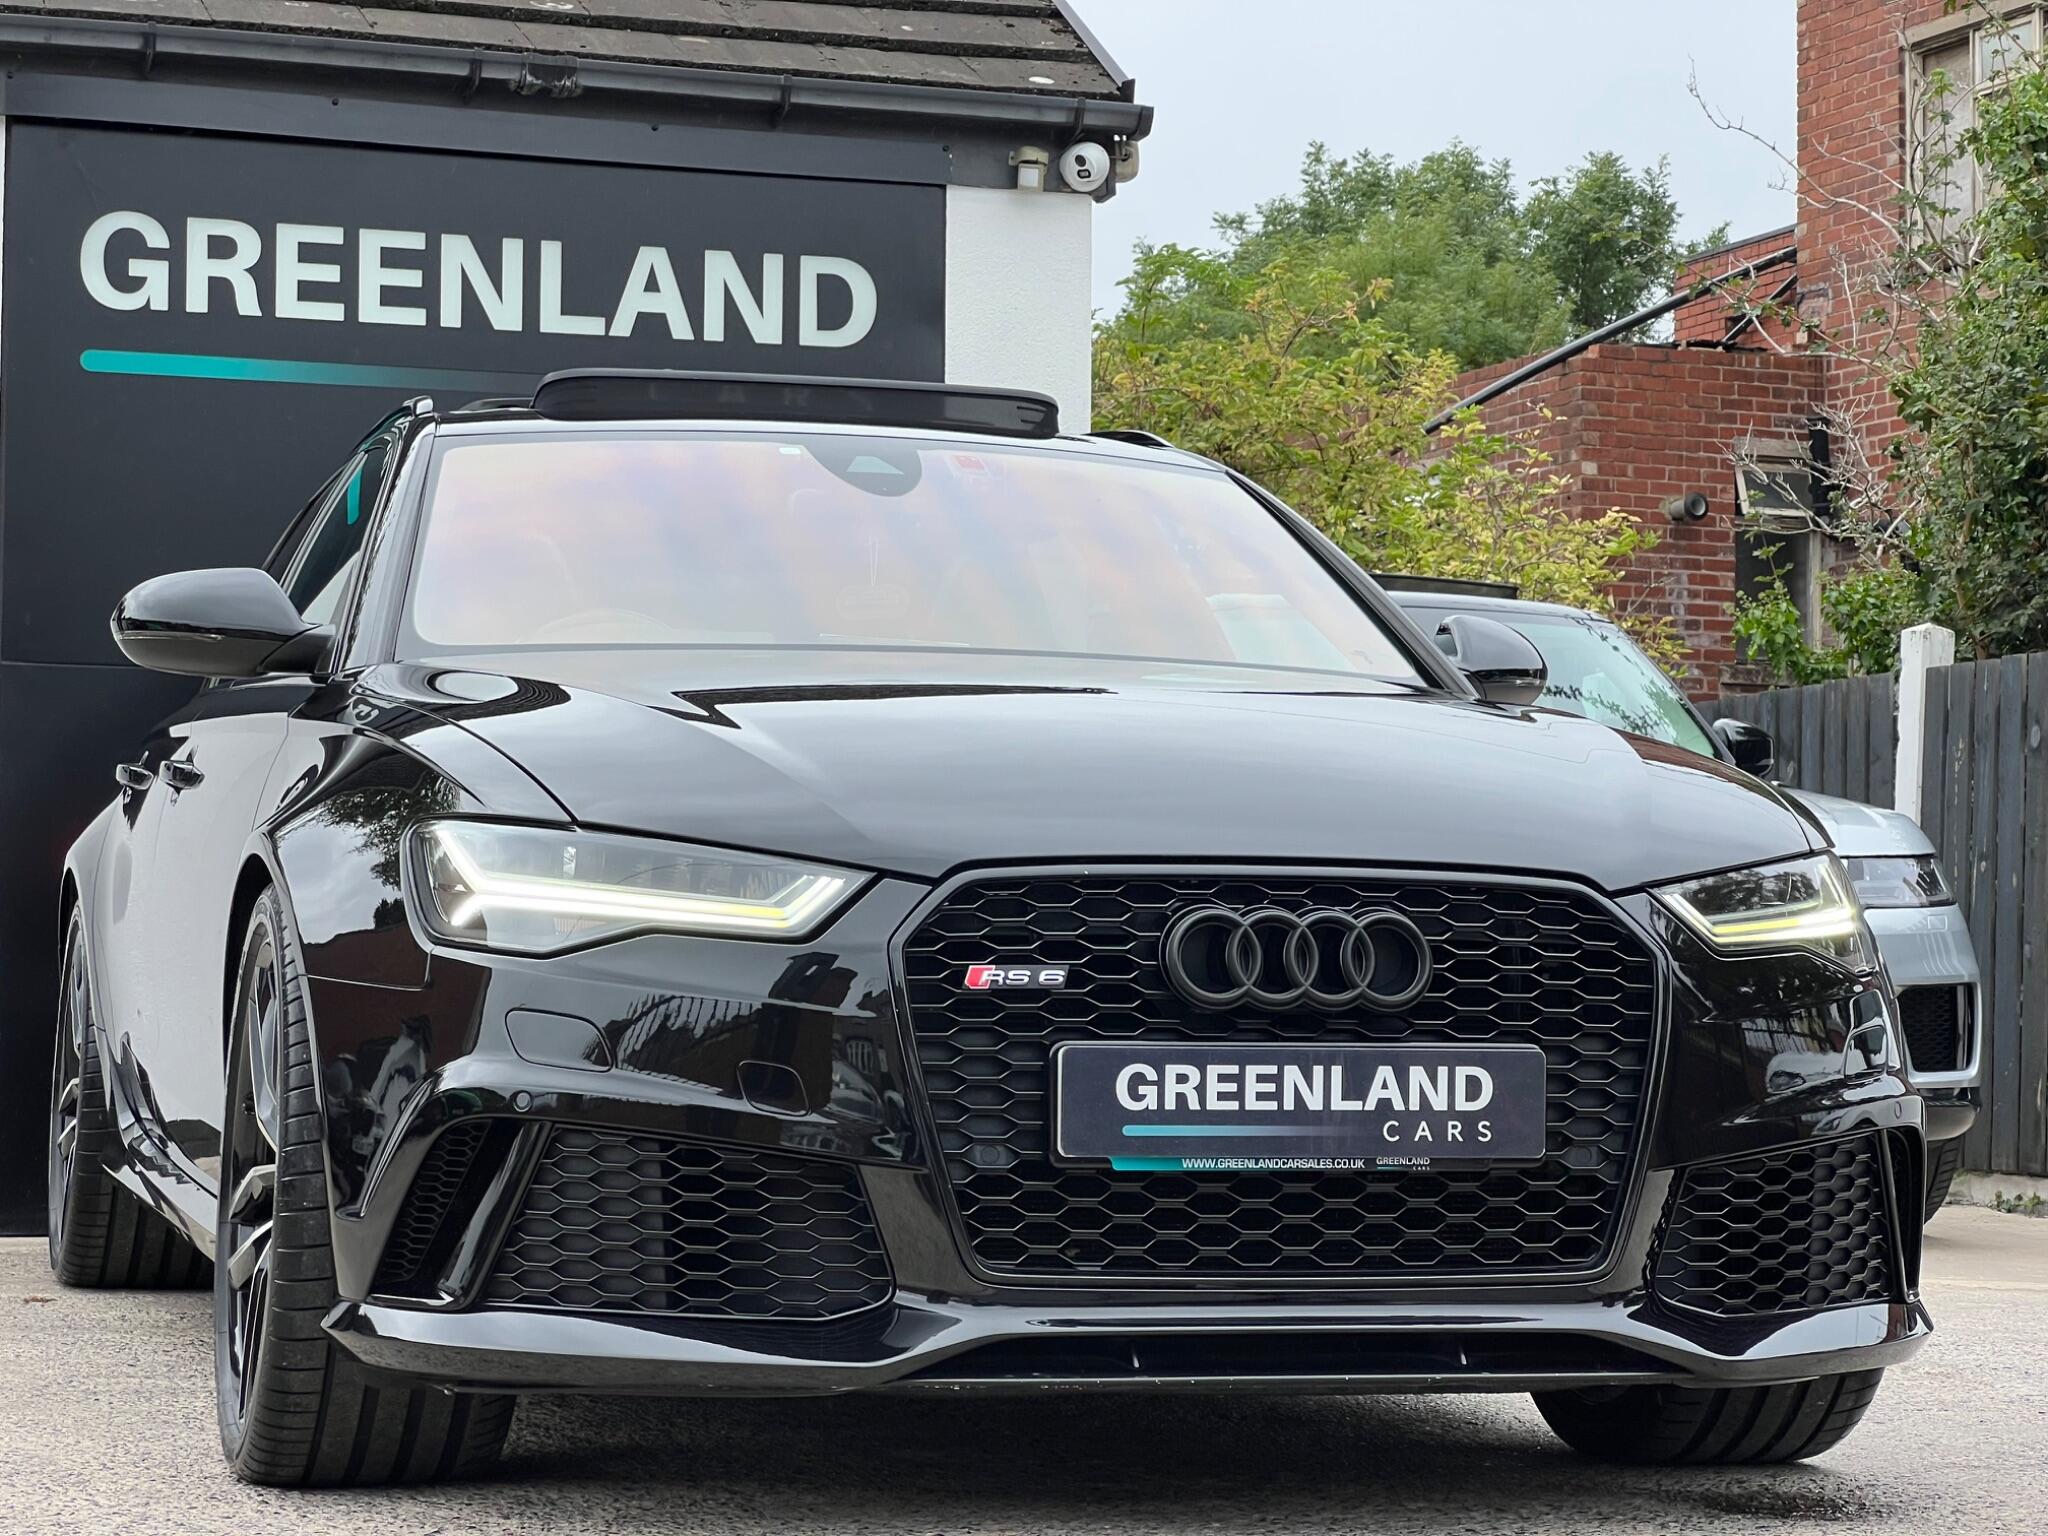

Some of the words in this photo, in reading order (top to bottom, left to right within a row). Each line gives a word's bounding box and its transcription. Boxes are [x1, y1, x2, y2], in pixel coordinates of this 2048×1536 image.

[80, 210, 878, 349] GREENLAND
[1115, 1063, 1494, 1112] GREENLAND
[1382, 1120, 1493, 1142] CARS
[1181, 1158, 1365, 1169] WWW.GREENLANDCARSALES.CO.UK
[1376, 1156, 1431, 1165] GREENLAND
